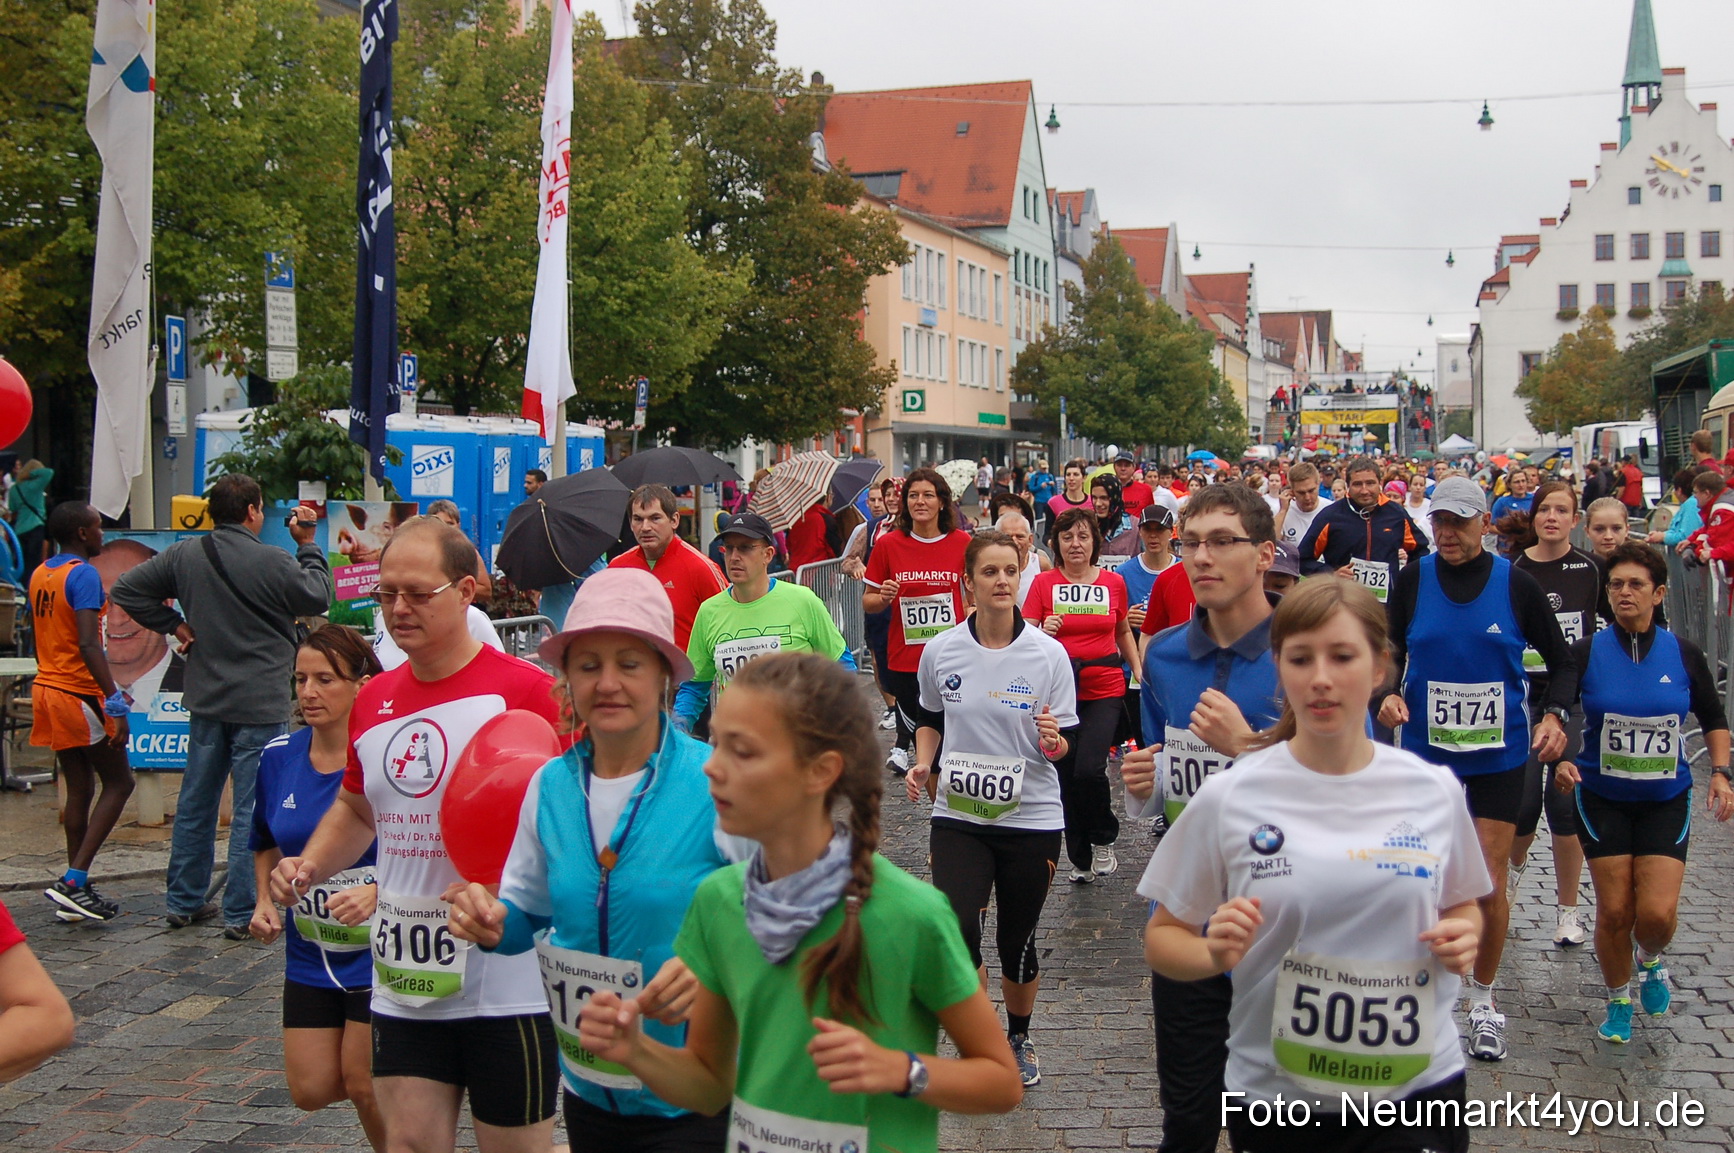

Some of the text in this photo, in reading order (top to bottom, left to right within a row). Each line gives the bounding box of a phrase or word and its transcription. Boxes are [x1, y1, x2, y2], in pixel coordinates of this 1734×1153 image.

[171, 325, 180, 372] P
[404, 359, 414, 387] P
[638, 383, 646, 404] P
[905, 392, 922, 410] D
[1332, 413, 1364, 422] START
[895, 571, 952, 580] NEUMARKT
[1353, 568, 1386, 587] 5132
[1058, 584, 1104, 603] 5079
[907, 606, 951, 625] 5075
[1068, 606, 1094, 614] Christa
[920, 628, 939, 637] Anita
[737, 643, 768, 652] Neumarkt
[1454, 690, 1490, 698] Neumarkt
[1435, 699, 1497, 726] 5174
[126, 733, 190, 754] ACKER
[1440, 730, 1488, 742] ERNST
[1609, 729, 1671, 754] 5173
[945, 759, 1009, 771] PARTL Neumarkt
[1609, 756, 1666, 769] KAROLA
[950, 770, 1014, 802] 5069
[1170, 755, 1233, 798] 505
[409, 813, 431, 824] MIT
[973, 802, 989, 816] Ute
[413, 832, 427, 841] Dr.
[1250, 857, 1292, 871] PARTL
[1251, 868, 1292, 880] Neumarkt
[378, 899, 447, 919] PARTL Neumarkt
[320, 927, 348, 941] Hilde
[376, 918, 455, 966] 5106
[555, 960, 616, 984] Neumarkt
[1283, 959, 1410, 988] PARTL Neumarkt
[1291, 983, 1420, 1047] 5053
[1308, 1053, 1392, 1080] Melanie
[733, 1111, 758, 1139] PARTL
[760, 1127, 833, 1153] Neumarkt
